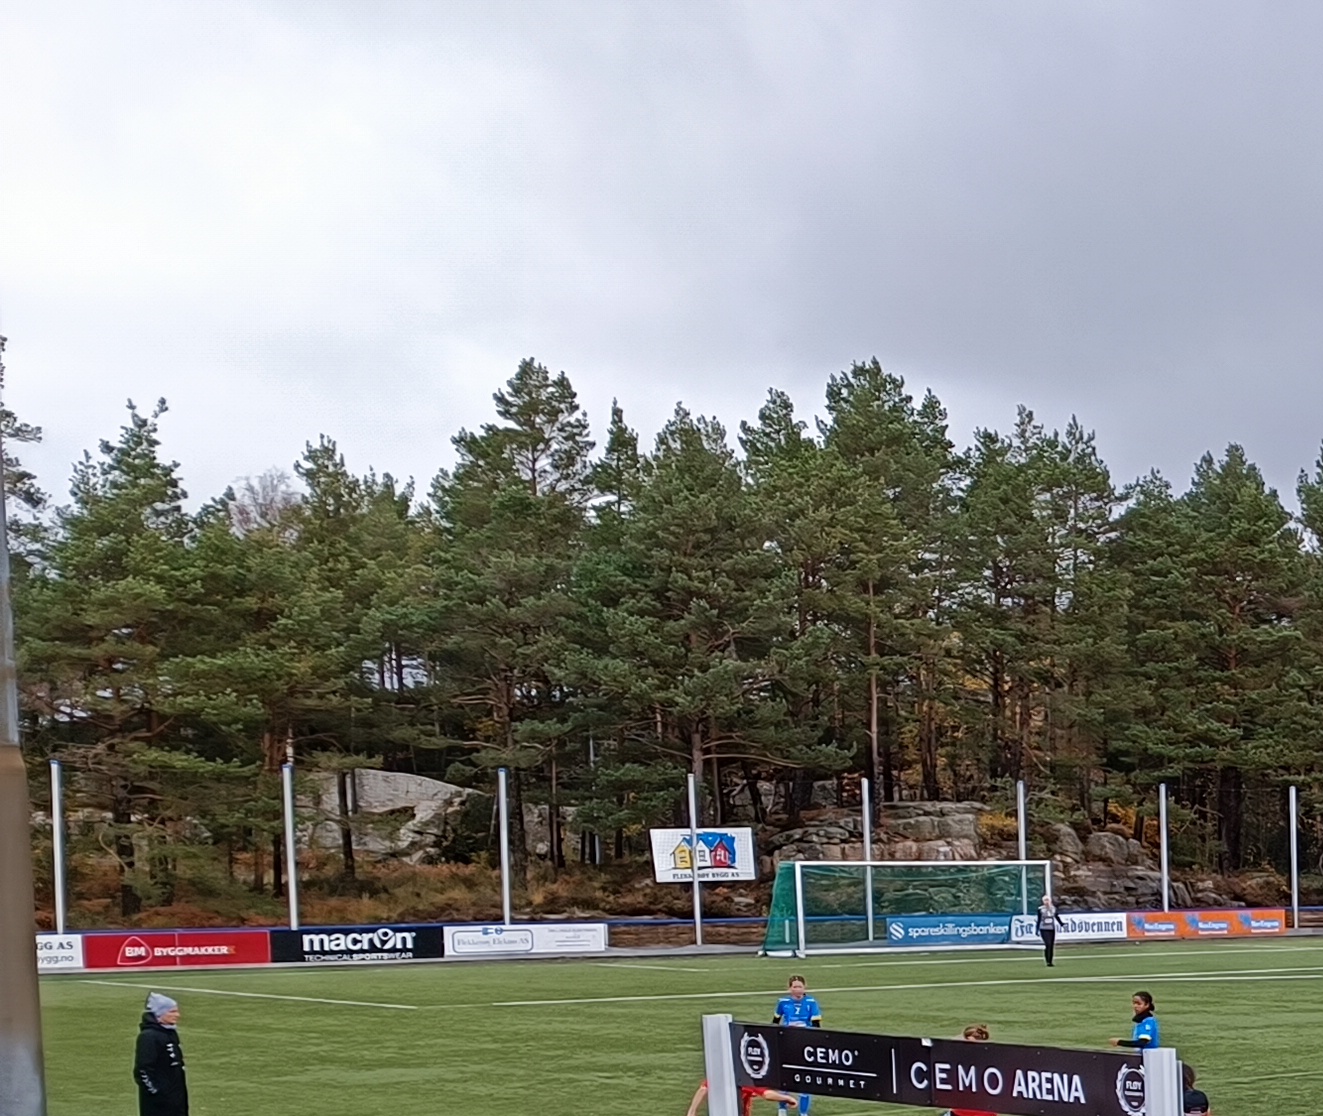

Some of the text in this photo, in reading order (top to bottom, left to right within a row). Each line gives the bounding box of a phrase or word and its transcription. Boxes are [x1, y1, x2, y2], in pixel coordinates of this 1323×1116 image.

[57, 941, 74, 950] AS
[302, 928, 414, 951] macron
[125, 947, 146, 957] BM
[154, 946, 229, 956] BYGGMAKKER
[804, 1046, 854, 1066] CEMO
[794, 1074, 866, 1089] GOURMET
[910, 1062, 1086, 1104] CEMO ARENA
